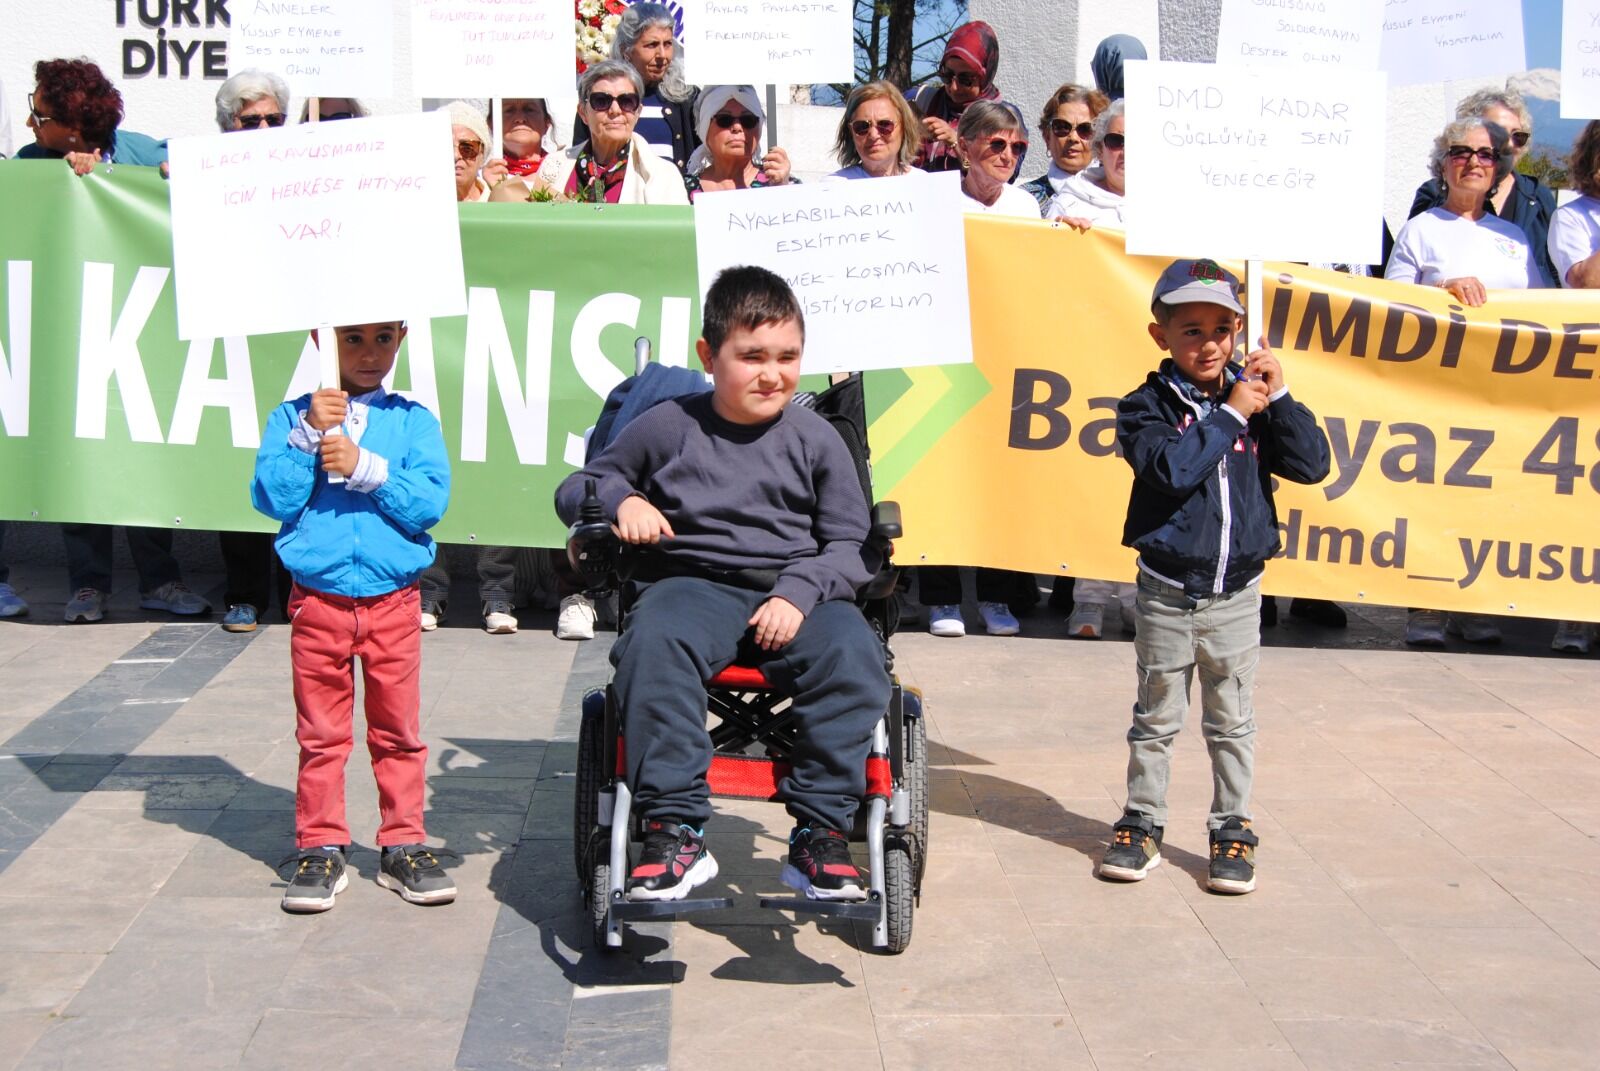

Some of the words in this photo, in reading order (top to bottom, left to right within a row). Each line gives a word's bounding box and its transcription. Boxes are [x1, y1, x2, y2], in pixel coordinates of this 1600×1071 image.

[253, 0, 336, 15] ANNELER
[240, 23, 282, 38] YUSUF
[287, 26, 343, 38] EYMENE
[122, 28, 229, 80] DİYE
[245, 45, 272, 55] SES
[279, 46, 310, 55] OLUN
[320, 45, 365, 55] NEFES
[1240, 42, 1289, 57] DESTEK
[1302, 51, 1341, 64] OLUN
[285, 63, 321, 76] OLUN
[1158, 86, 1224, 111] DMD
[1260, 95, 1349, 122] KADAR
[271, 176, 345, 202] HERKESE
[727, 201, 914, 232] AYAKKABILARIMI
[279, 218, 342, 240] VAR!
[776, 229, 897, 253] ESKİTMEK
[845, 260, 942, 280] KOŞMAK
[803, 292, 933, 316] İSTİYORUM
[1240, 273, 1468, 369] İMDİ
